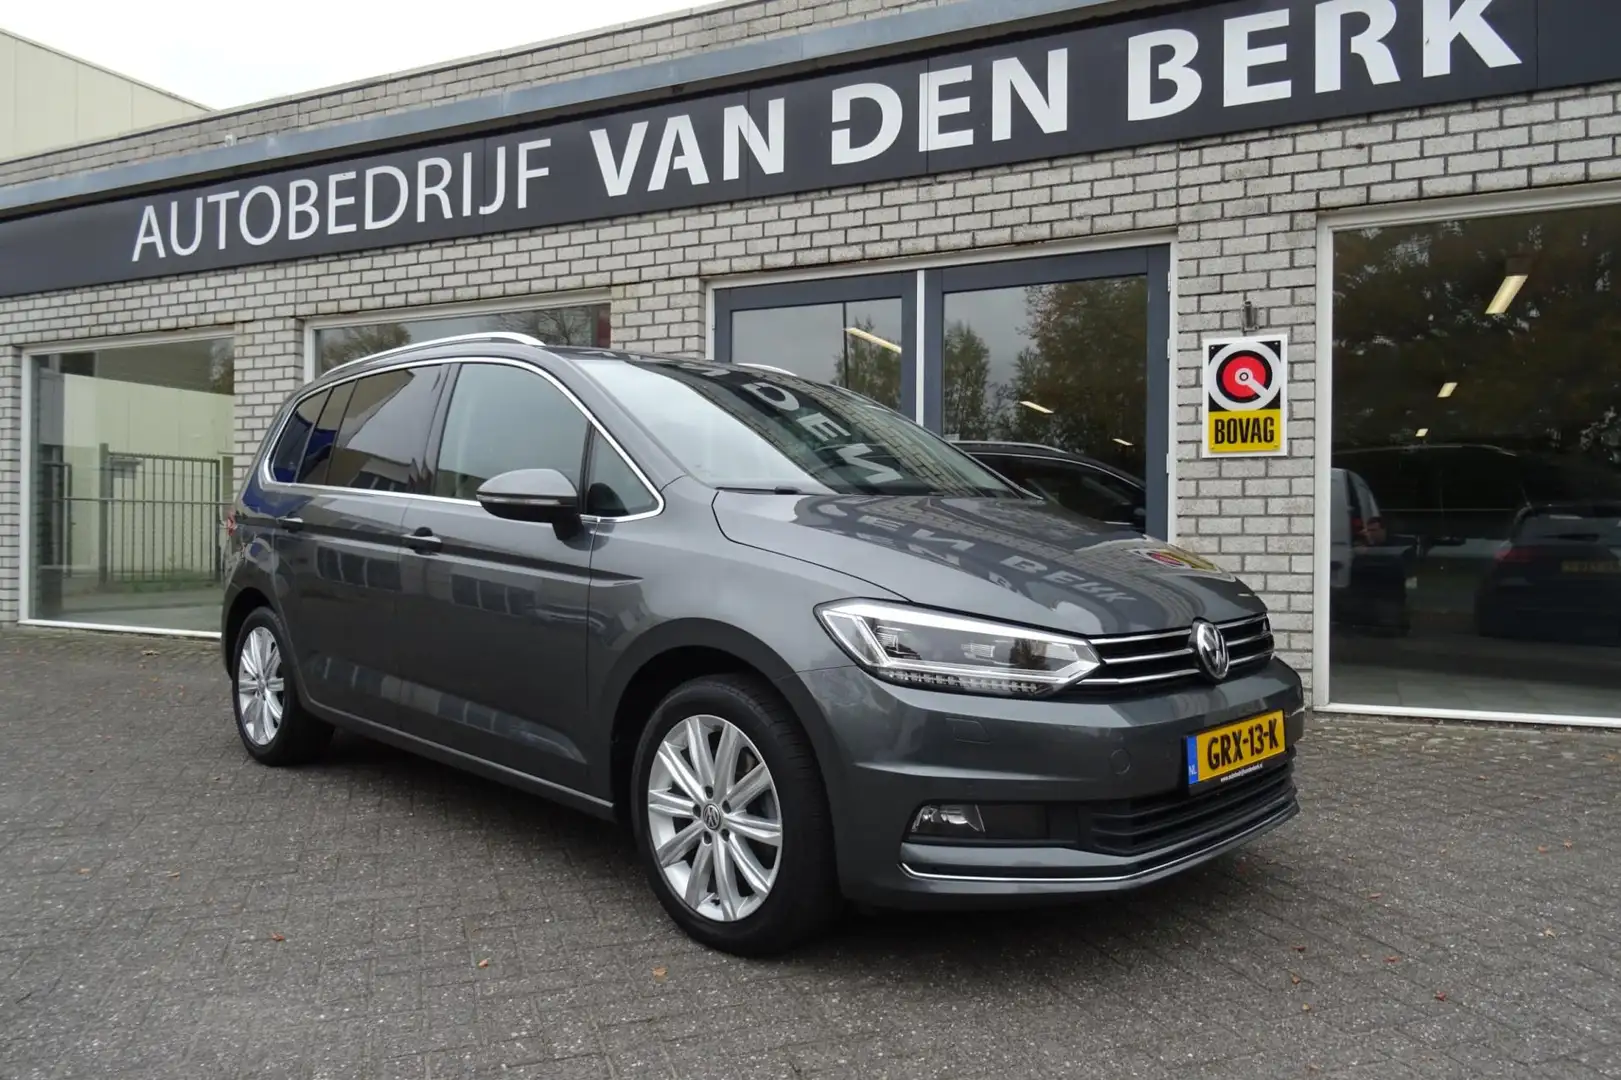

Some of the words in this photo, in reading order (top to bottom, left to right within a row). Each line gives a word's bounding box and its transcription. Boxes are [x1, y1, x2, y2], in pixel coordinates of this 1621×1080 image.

[131, 138, 552, 262] AUTOBEDRIJF
[589, 97, 785, 197] VAN
[831, 47, 1068, 165] DEN
[1127, 0, 1522, 122] BERK
[1214, 416, 1274, 445] BOVAG
[1207, 718, 1279, 770] GRX-13-K
[1188, 764, 1198, 776] NL
